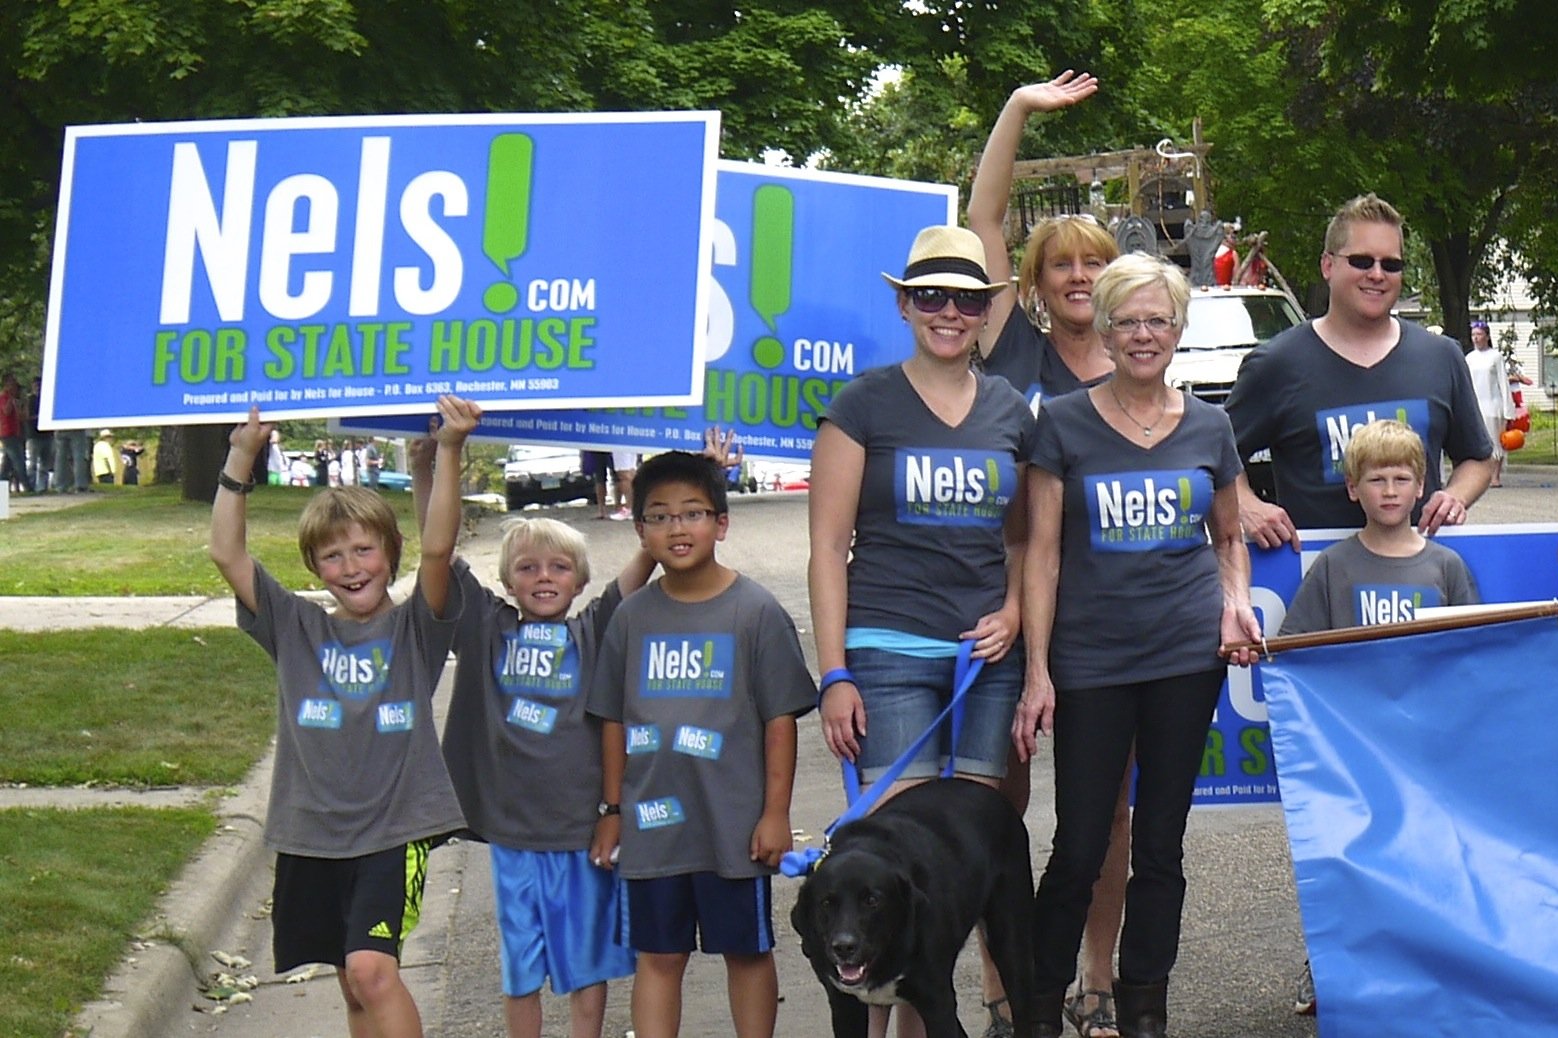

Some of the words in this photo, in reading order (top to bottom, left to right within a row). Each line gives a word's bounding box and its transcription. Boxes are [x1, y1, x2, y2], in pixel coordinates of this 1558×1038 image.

[159, 132, 535, 325] Nels!
[527, 278, 596, 312] COM
[152, 328, 248, 385] FOR
[263, 321, 413, 380] STATE
[428, 316, 597, 374] HOUSE
[793, 338, 854, 375] COM
[183, 391, 228, 406] Prepared
[230, 390, 249, 404] and
[250, 390, 273, 403] Paid
[274, 388, 289, 401] for
[290, 388, 303, 402] by
[304, 387, 327, 400] Nels
[329, 386, 342, 399] for
[344, 385, 375, 399] House
[384, 383, 402, 396] P.O.
[405, 383, 423, 395] Box
[455, 380, 508, 394] Rochester,
[510, 379, 526, 391] MN
[528, 378, 560, 391] 55903
[515, 416, 534, 429] and
[536, 418, 558, 431] Paid
[561, 420, 573, 432] for
[575, 421, 587, 434] by
[588, 422, 610, 435] Nels
[611, 423, 625, 436] for
[627, 426, 656, 438] House
[684, 428, 701, 440] Box
[779, 435, 795, 448] MN
[905, 455, 999, 504] Nels!
[1096, 476, 1192, 529] Nels!
[1101, 528, 1123, 543] FOR
[1129, 525, 1165, 542] STATE
[648, 640, 714, 680] Nels!
[1232, 785, 1252, 796] Paid
[1253, 785, 1265, 795] for
